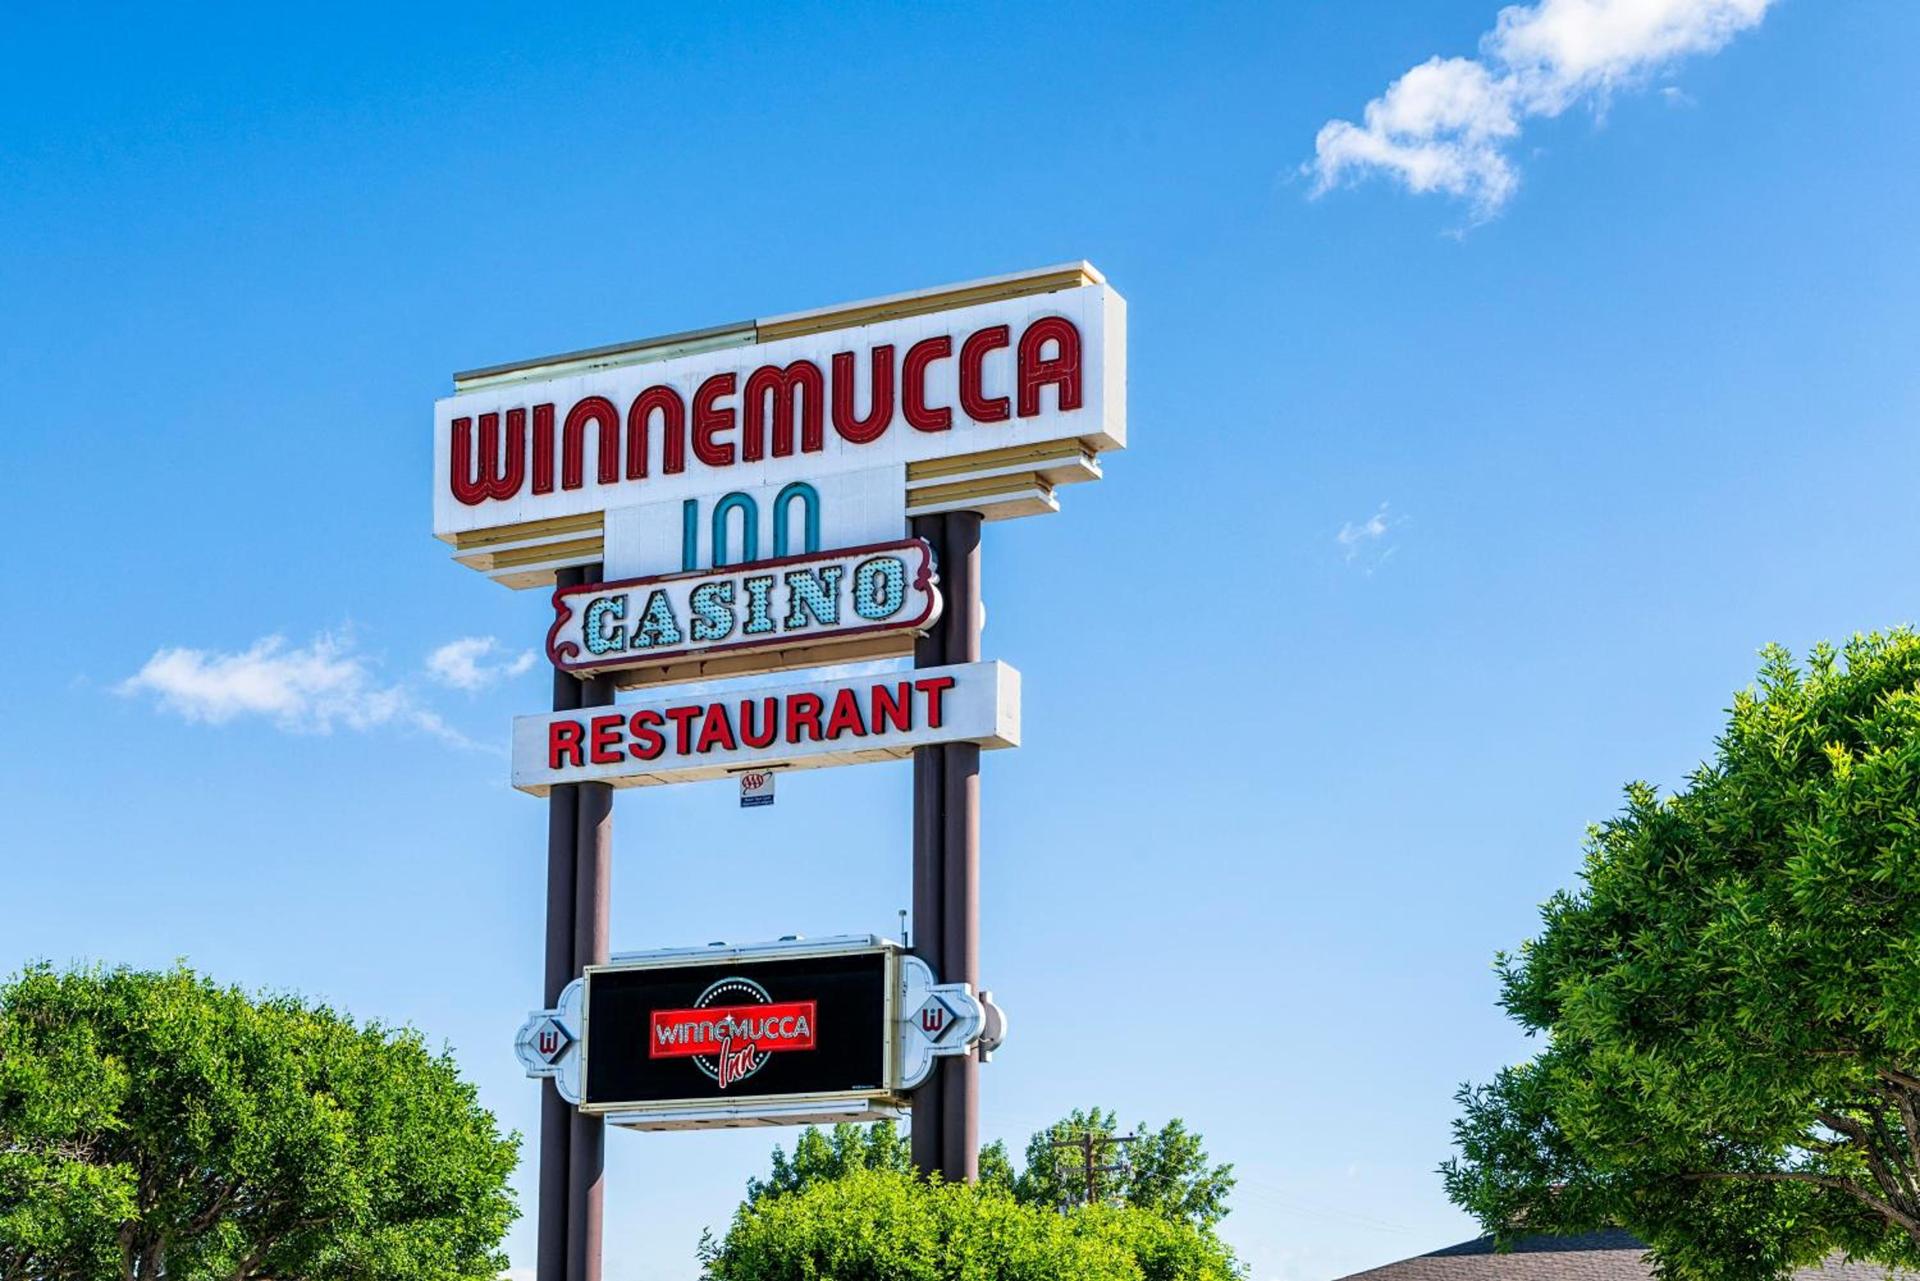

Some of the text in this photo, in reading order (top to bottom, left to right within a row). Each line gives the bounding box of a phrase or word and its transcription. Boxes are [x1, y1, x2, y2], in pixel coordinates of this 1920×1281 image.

[450, 316, 1083, 506] WINNEMUCCA
[582, 557, 908, 656] CASINO
[548, 677, 955, 769] RESTAURANT
[656, 1016, 810, 1045] WINNEMUCCA
[718, 1037, 757, 1088] Inn
